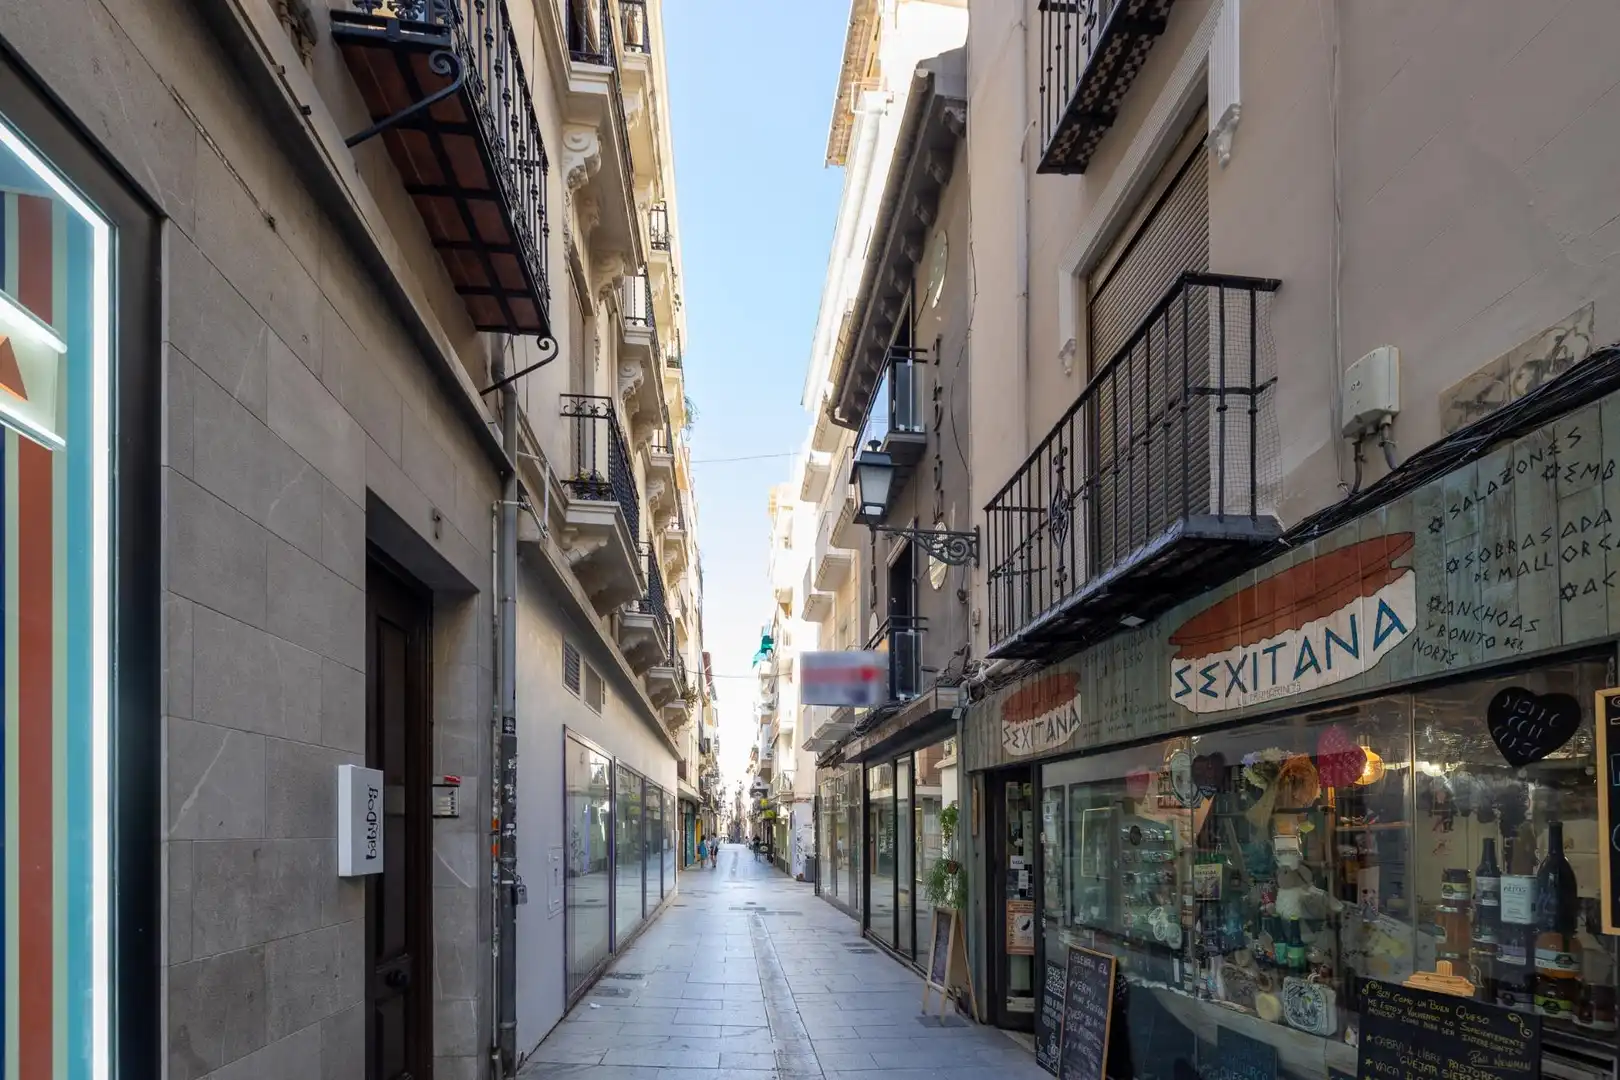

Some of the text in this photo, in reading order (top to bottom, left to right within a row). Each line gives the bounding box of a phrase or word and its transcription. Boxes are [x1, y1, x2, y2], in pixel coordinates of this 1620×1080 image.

[1449, 427, 1582, 519] SALAZONES
[1465, 508, 1613, 569] SOBRASADA
[1440, 599, 1541, 633] ANCHOAS
[1174, 597, 1408, 699] SEXITANA
[1412, 636, 1459, 665] NORTE
[1436, 623, 1496, 649] BONITO
[1002, 705, 1081, 749] SEXITANA
[1455, 1005, 1490, 1025] QUESO
[1374, 1060, 1400, 1078] VACA
